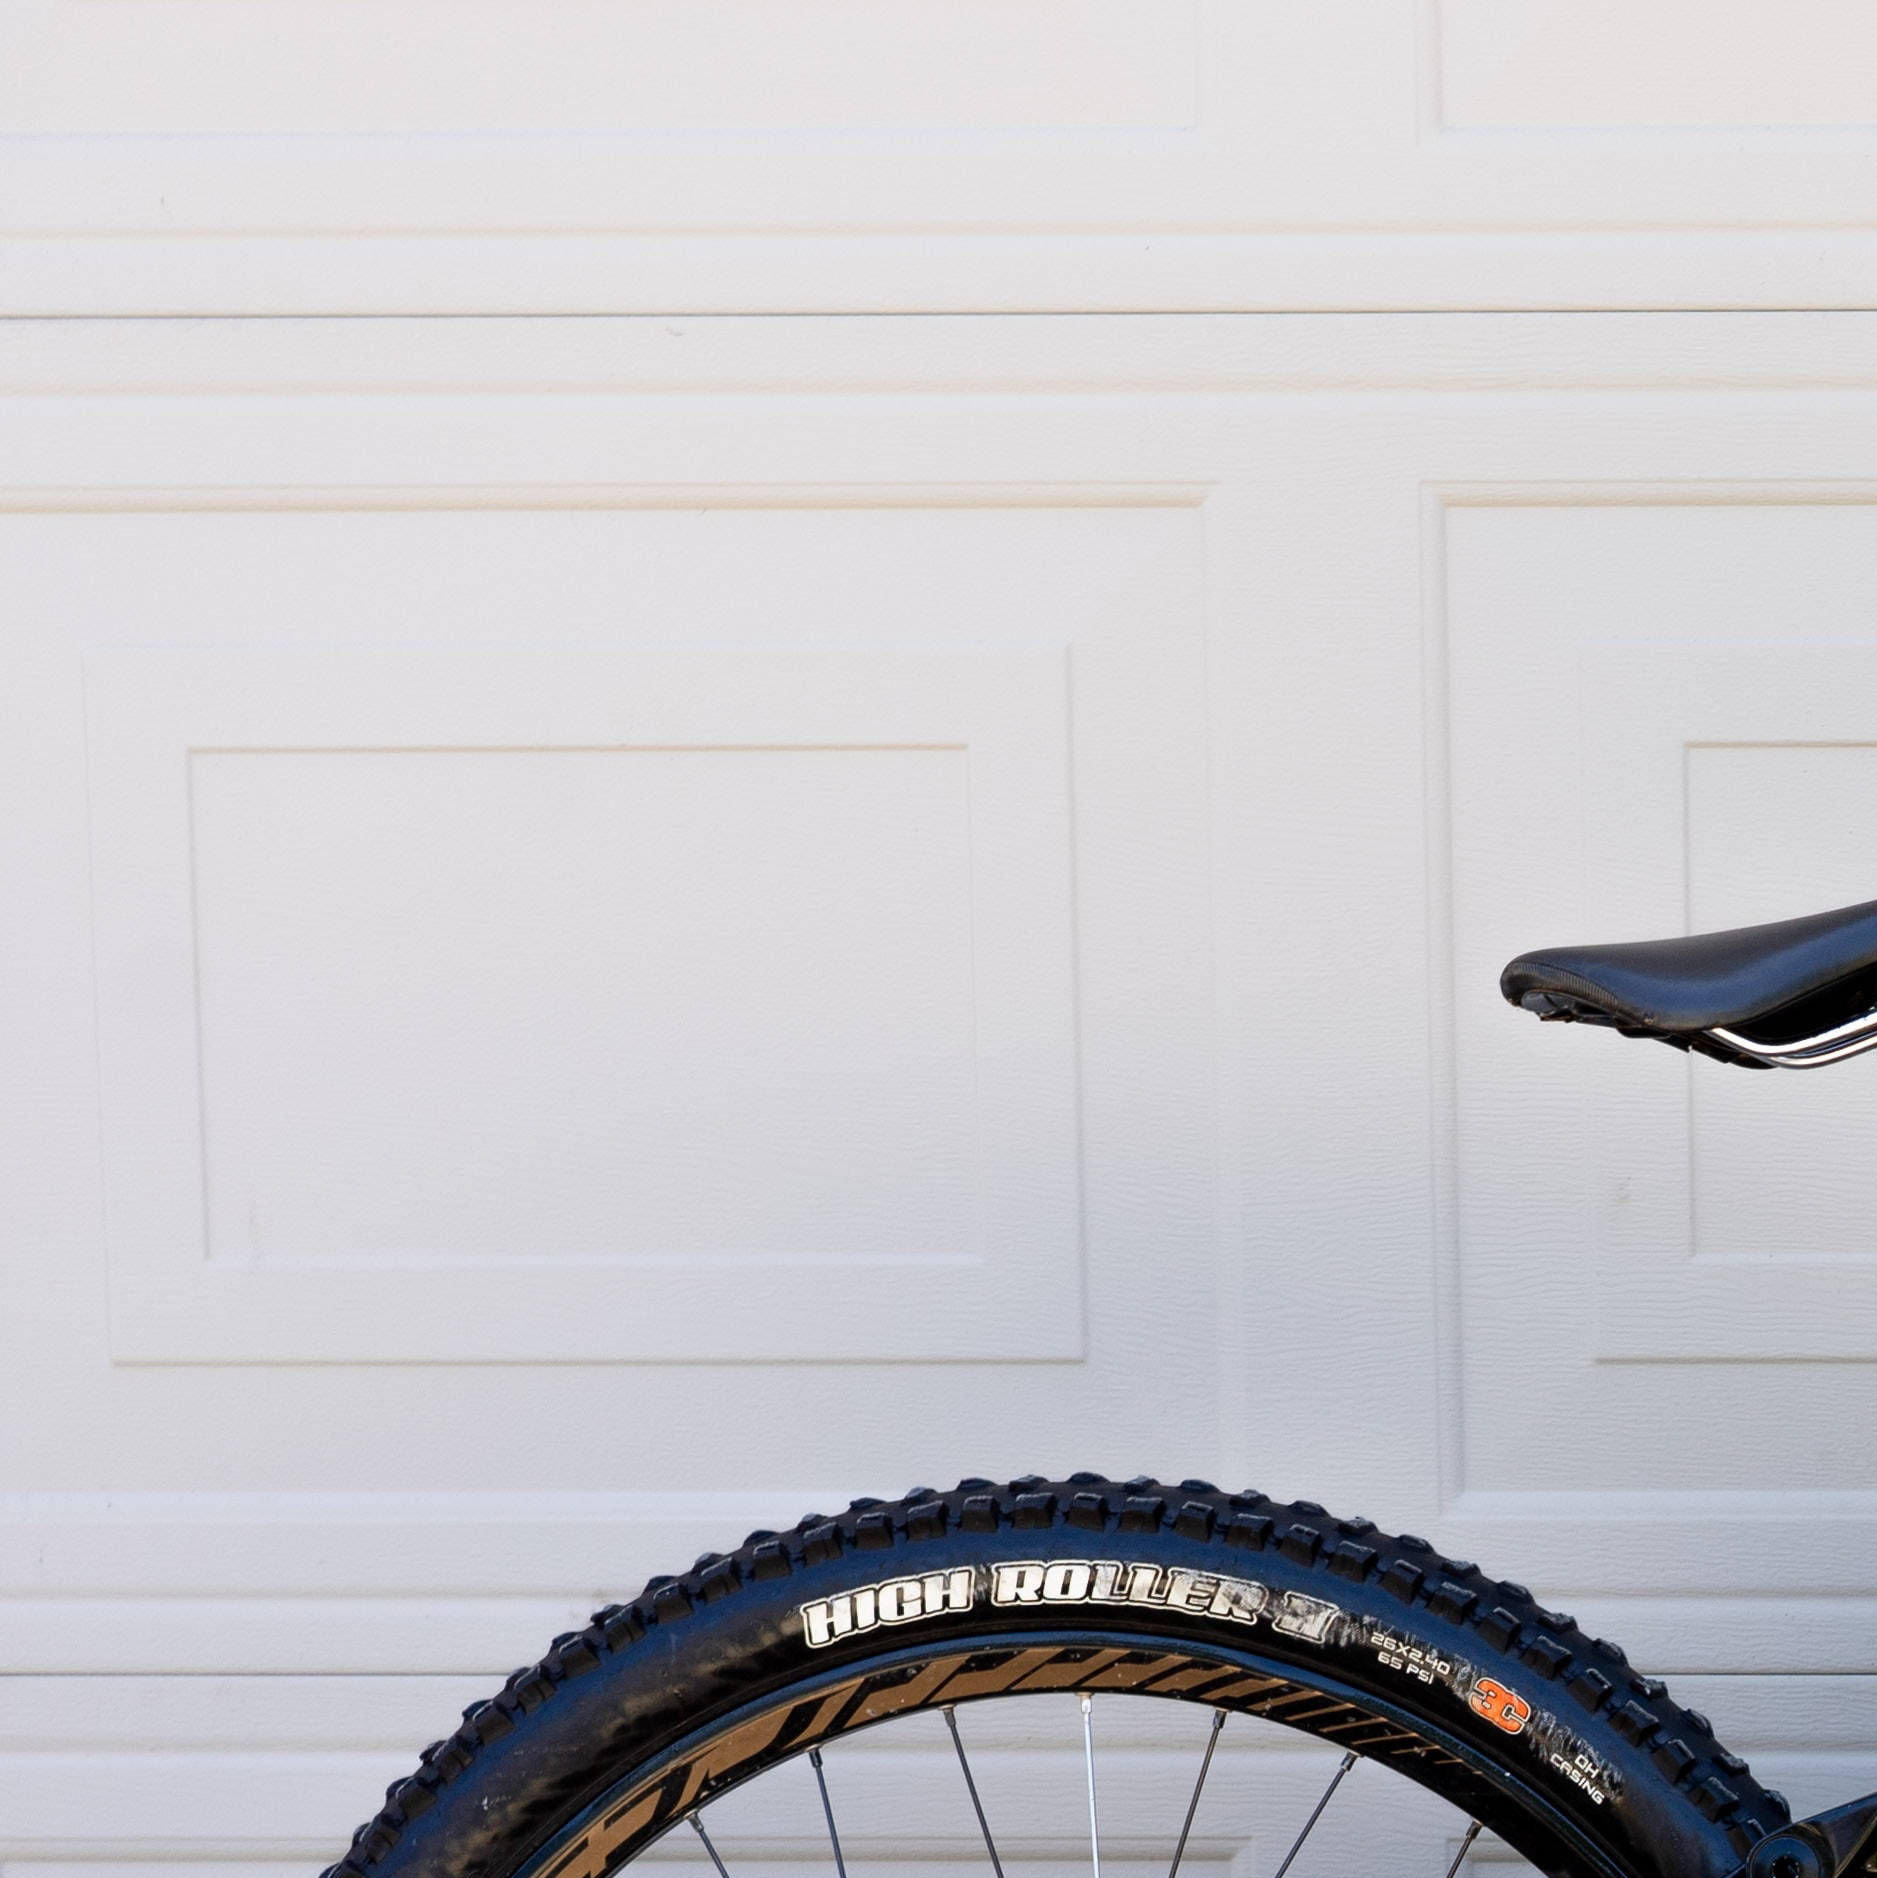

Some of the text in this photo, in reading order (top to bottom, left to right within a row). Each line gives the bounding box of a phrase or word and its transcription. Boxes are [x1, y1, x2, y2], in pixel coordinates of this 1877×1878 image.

[801, 1564, 974, 1649] HIGH
[991, 1559, 1271, 1625] ROLLER
[1377, 1651, 1435, 1685] 65 PSI
[1469, 1676, 1532, 1735] 3C
[1550, 1752, 1605, 1806] CASING
[1574, 1753, 1600, 1778] DH
